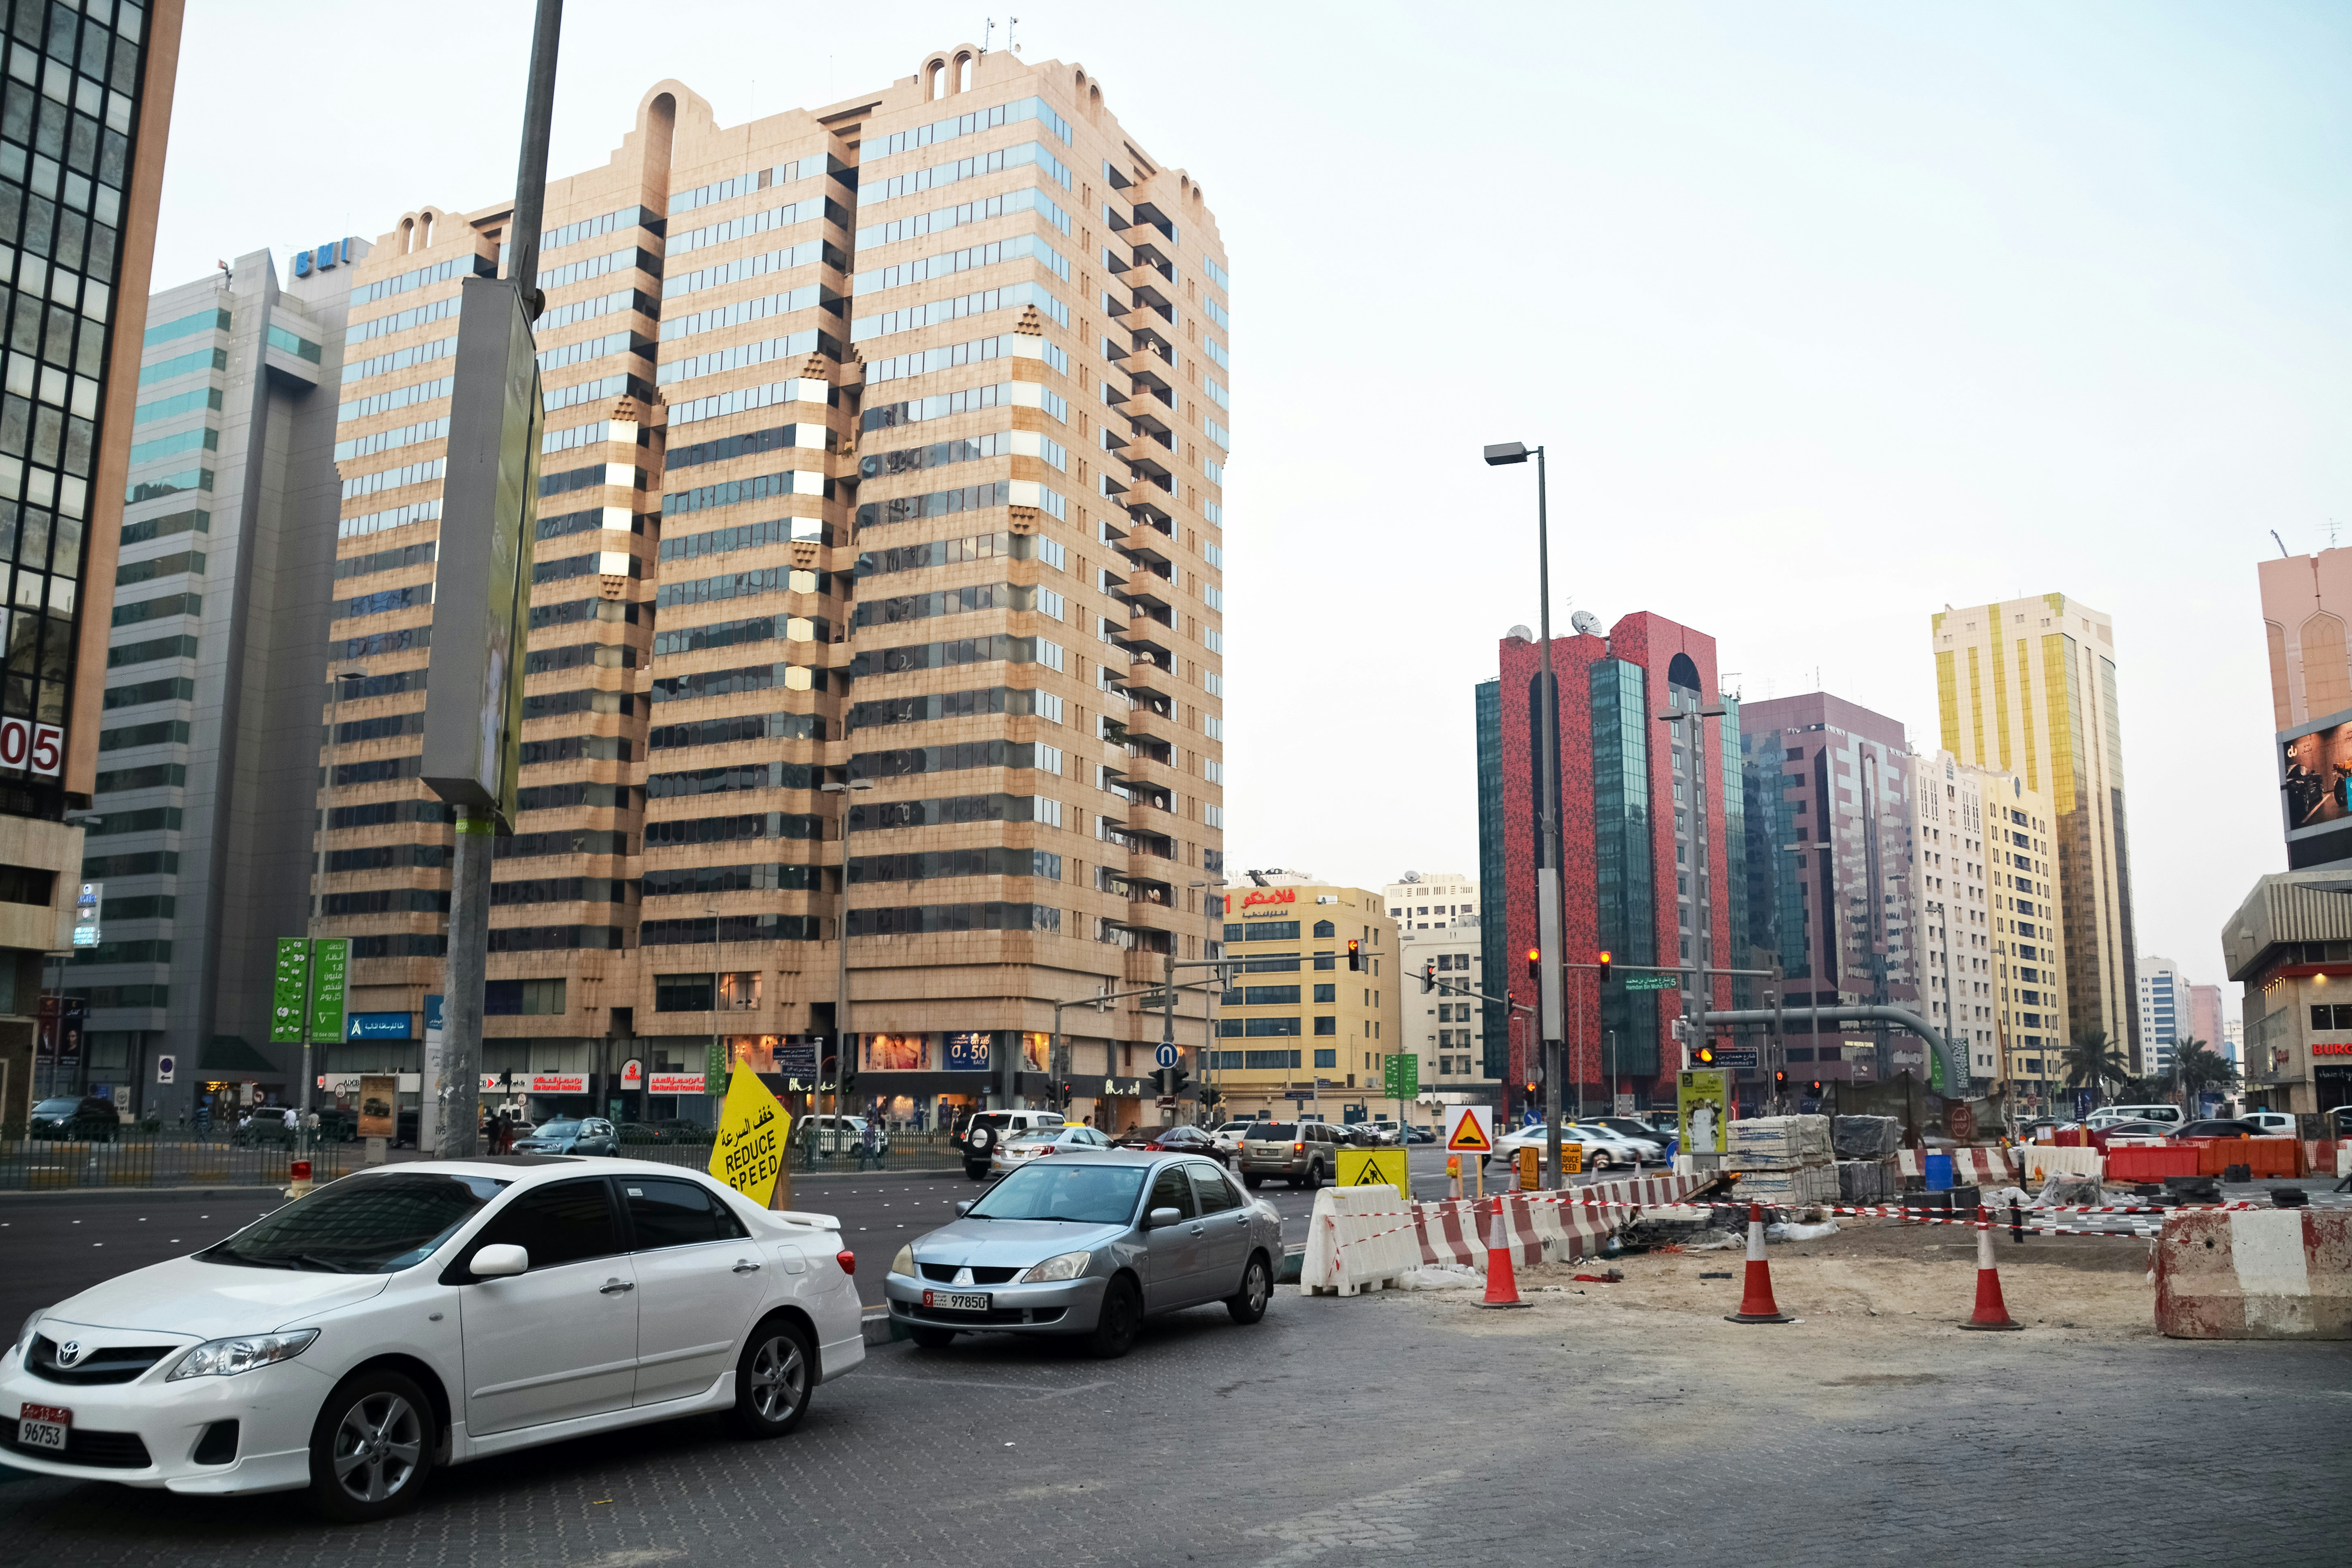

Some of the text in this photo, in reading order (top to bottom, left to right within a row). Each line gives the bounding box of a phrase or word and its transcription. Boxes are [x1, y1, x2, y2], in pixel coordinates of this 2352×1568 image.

[0, 722, 60, 771] 05
[1671, 978, 1676, 986] 5
[970, 1044, 988, 1060] 50
[721, 1104, 774, 1147] خفف السرعة
[725, 1129, 776, 1175] REDUCE
[730, 1154, 777, 1192] SPEED
[926, 1294, 931, 1304] 9
[951, 1295, 986, 1308] 97850
[25, 1422, 60, 1446] 96753
